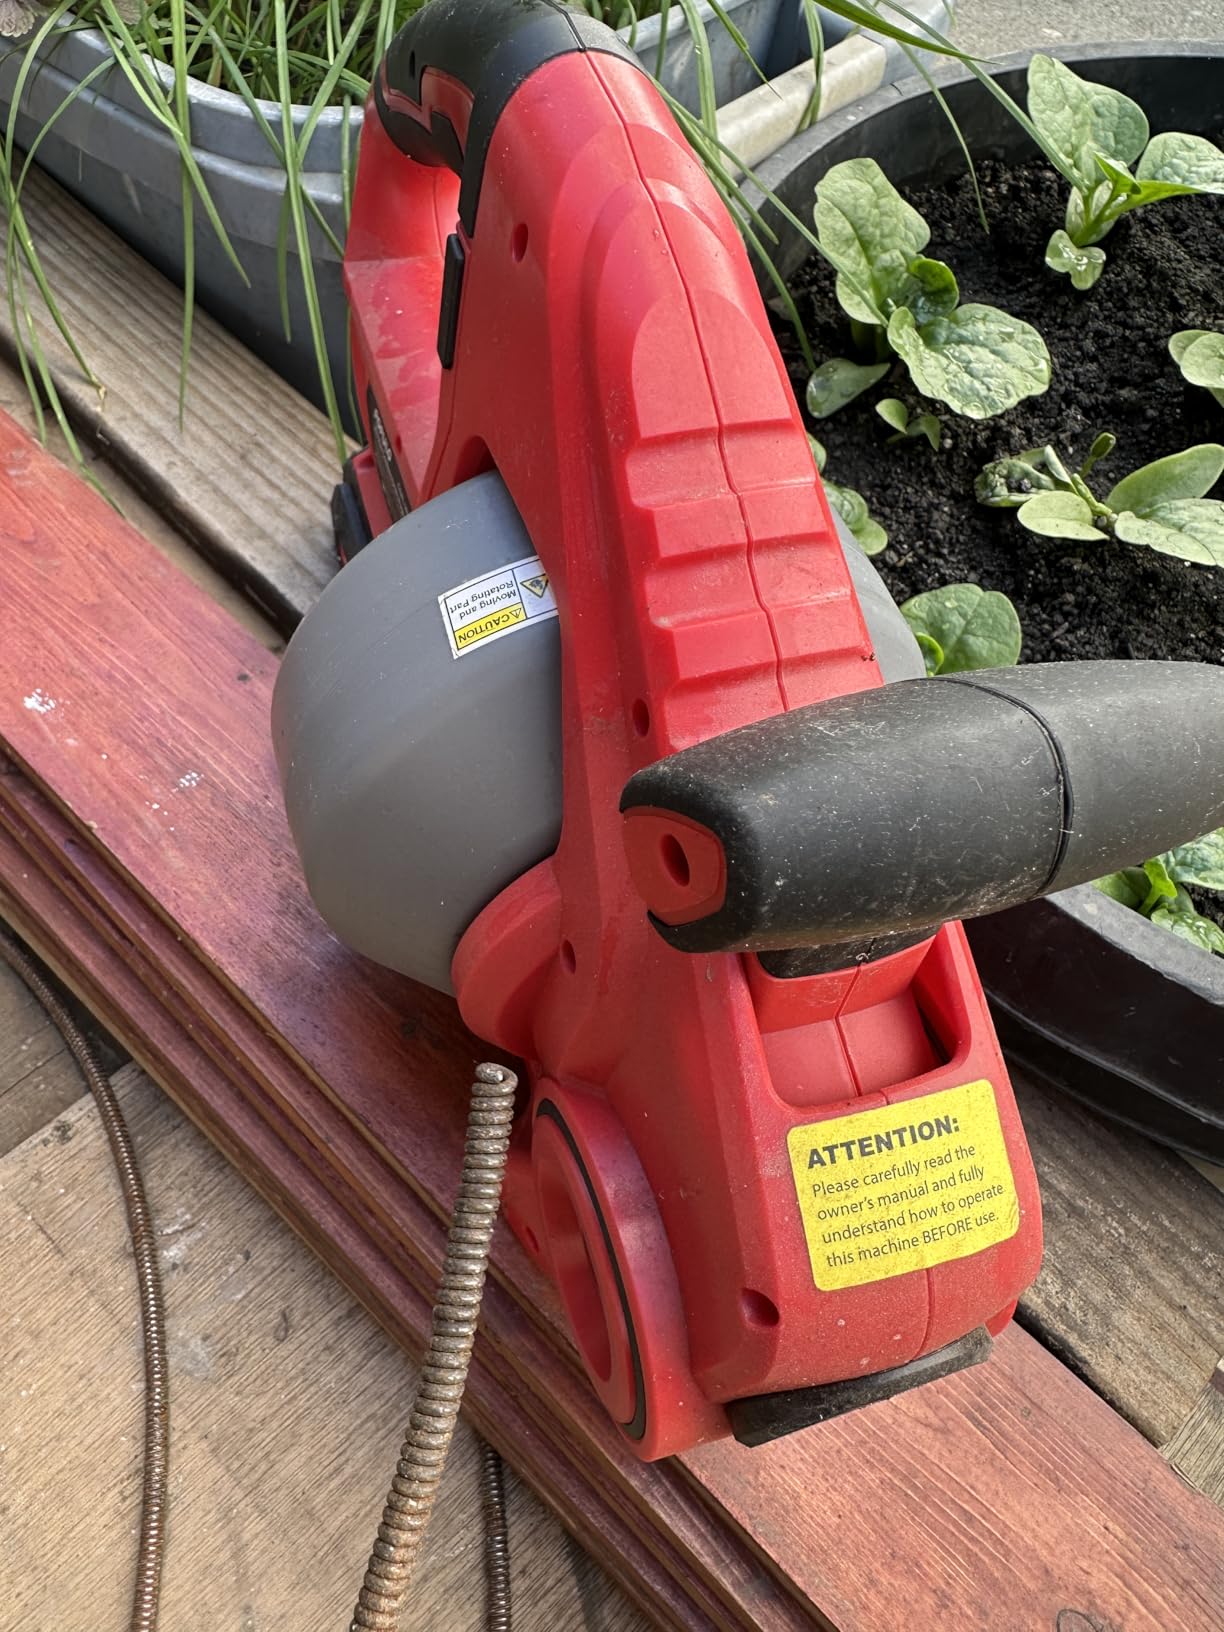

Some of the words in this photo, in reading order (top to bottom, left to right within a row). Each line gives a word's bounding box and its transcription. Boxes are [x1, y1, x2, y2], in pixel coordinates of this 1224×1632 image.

[450, 598, 469, 613] Part
[472, 581, 514, 601] Rotating
[480, 590, 516, 608] Moving
[458, 614, 509, 643] CAUTION
[460, 606, 477, 619] and
[807, 1114, 960, 1169] ATTENTION:
[813, 1178, 859, 1197] Please
[863, 1159, 921, 1185] carefully
[924, 1151, 953, 1169] read
[955, 1144, 976, 1160] the
[818, 1197, 875, 1220] owner's
[878, 1183, 929, 1206] manual
[932, 1175, 956, 1192] and
[959, 1166, 984, 1184] fully
[822, 1210, 905, 1244] understand
[909, 1205, 938, 1223] how
[940, 1200, 956, 1214] to
[958, 1183, 1004, 1209] operate
[827, 1252, 854, 1268] this
[858, 1235, 919, 1261] machine
[922, 1221, 972, 1244] BEFORE
[975, 1212, 999, 1227] use.
